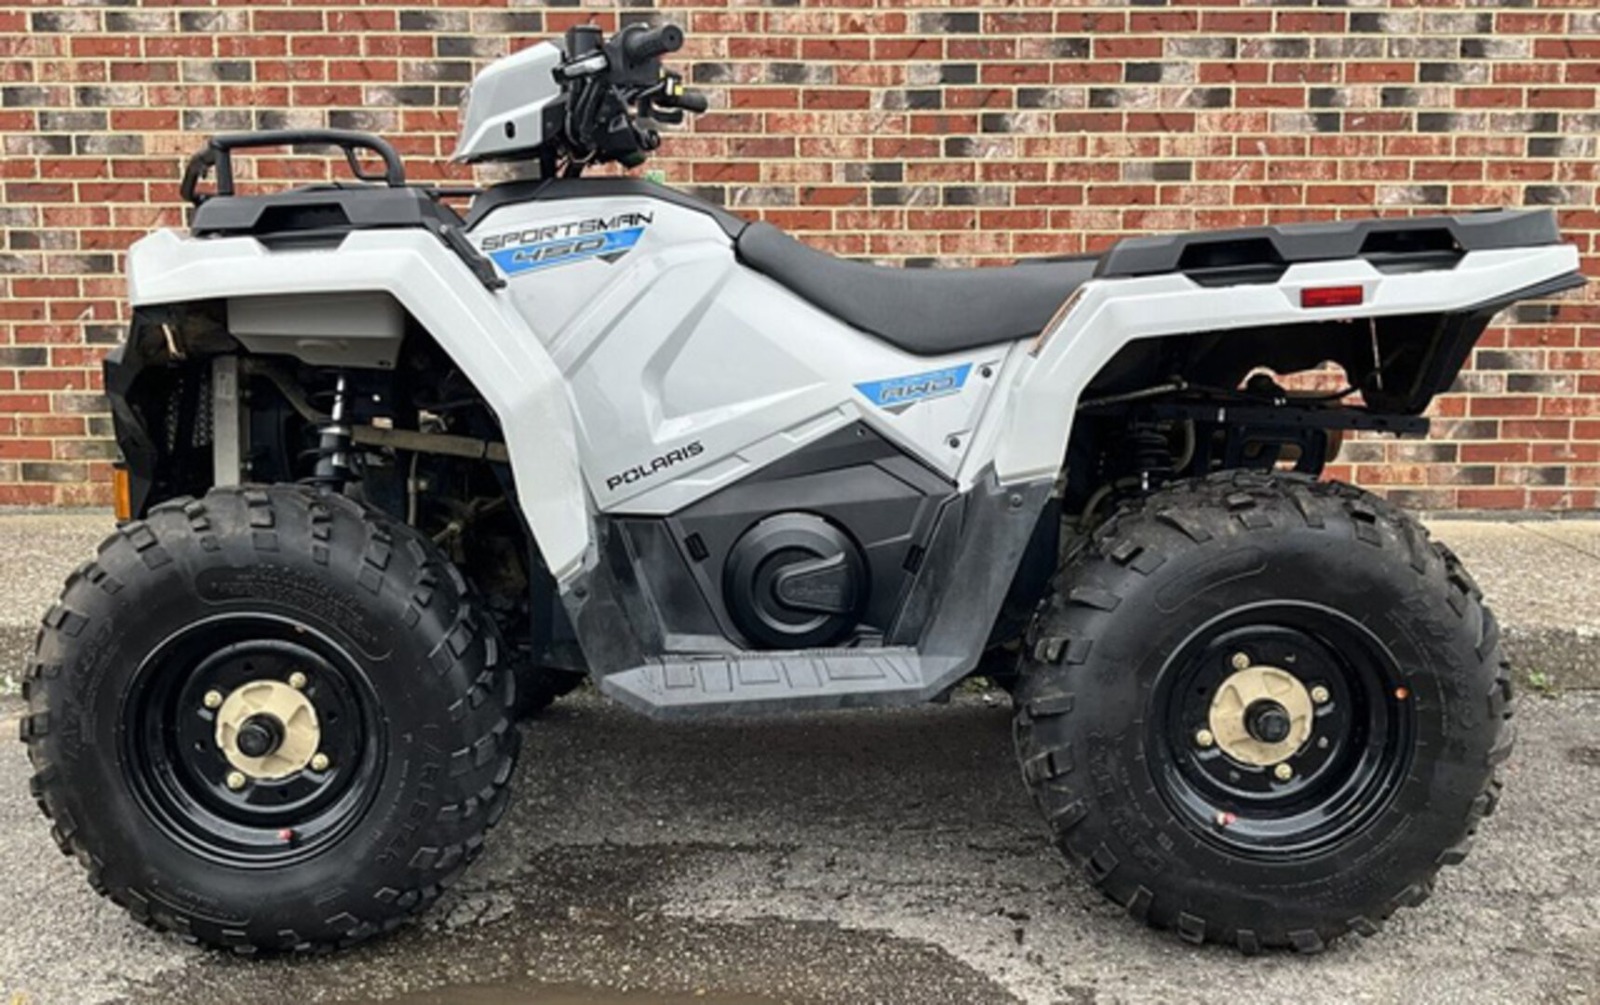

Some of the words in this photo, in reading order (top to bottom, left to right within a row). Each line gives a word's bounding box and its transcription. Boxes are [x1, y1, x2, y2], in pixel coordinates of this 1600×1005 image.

[481, 211, 654, 251] SPORTSMAN
[514, 236, 606, 262] 450
[606, 440, 704, 491] POLARIS
